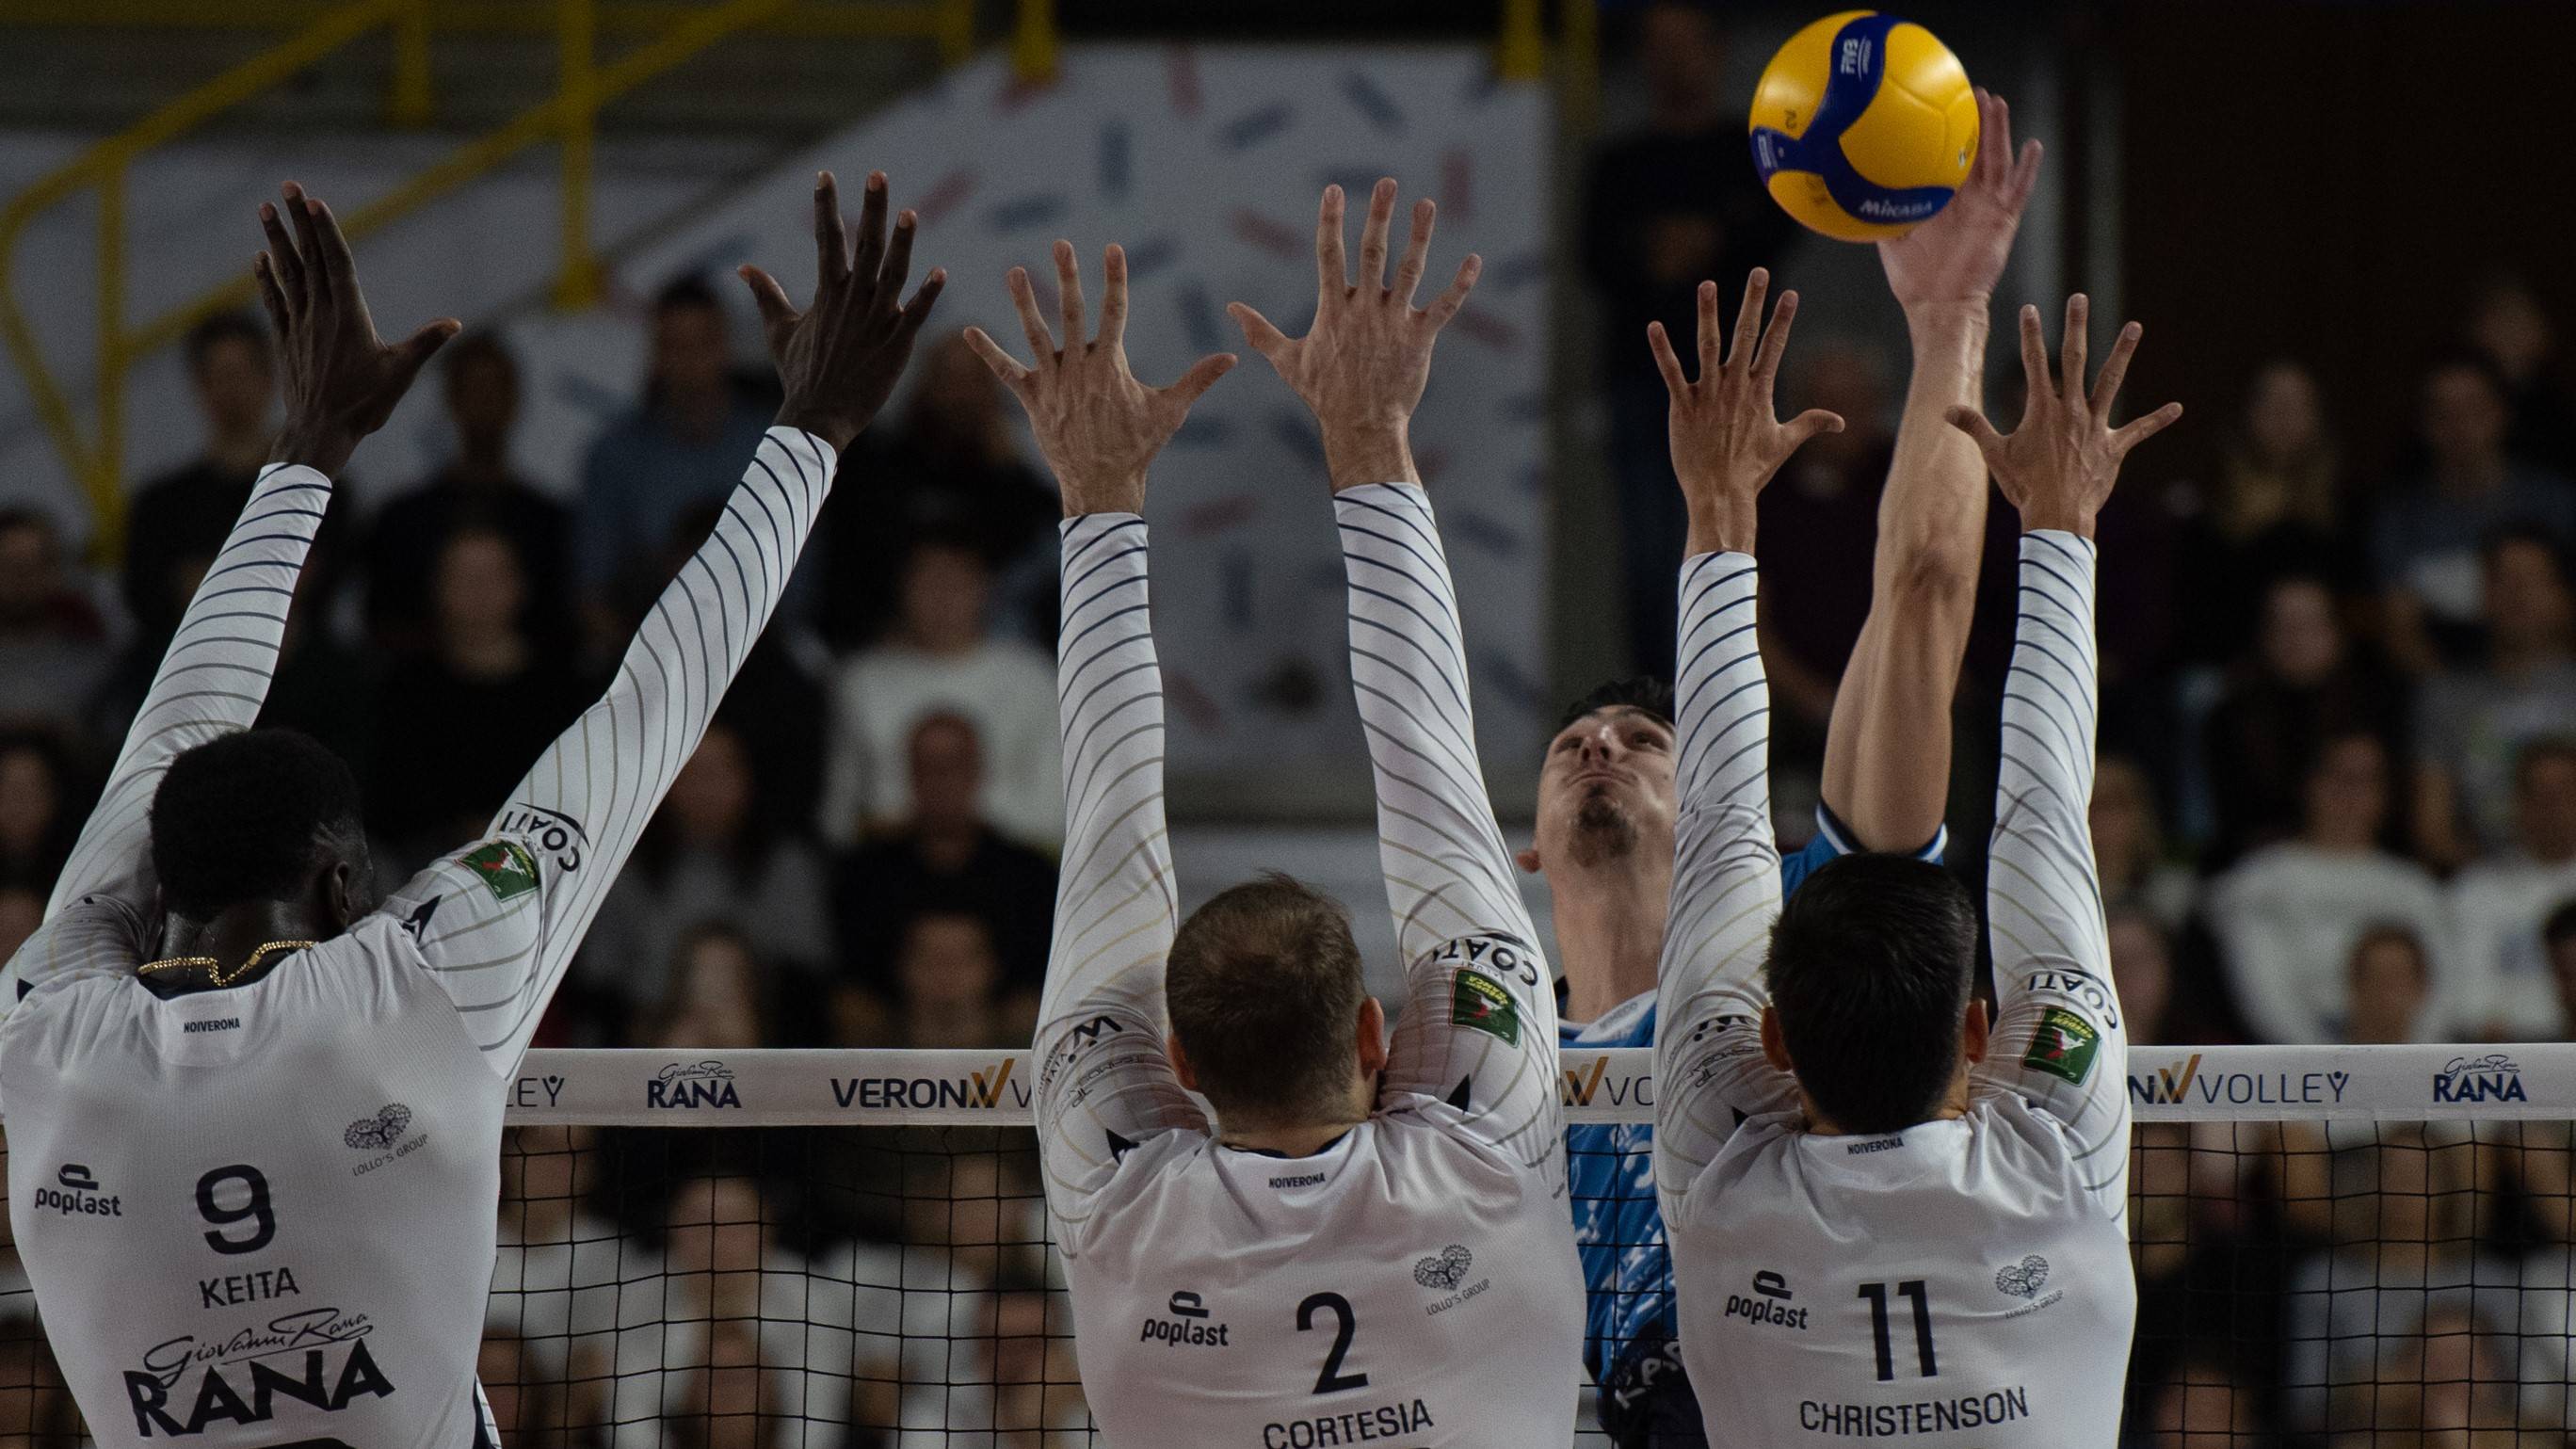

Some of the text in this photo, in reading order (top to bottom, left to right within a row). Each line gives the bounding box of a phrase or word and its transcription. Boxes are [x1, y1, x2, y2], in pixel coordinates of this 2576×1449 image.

[2028, 974, 2117, 1029] COATI
[184, 1018, 240, 1033] NOIVERONA
[648, 1080, 742, 1108] RANA
[2198, 1071, 2350, 1103] VOLLEY
[2434, 1073, 2527, 1103] RANA
[396, 1134, 428, 1157] GROUP
[1846, 1137, 1904, 1155] NOIVERONA
[1268, 1173, 1326, 1189] NOIVERONA
[35, 1187, 122, 1216] poplast
[195, 1165, 276, 1255] 9
[199, 1267, 300, 1309] KEITA
[1462, 1279, 1489, 1299] GROUP
[1725, 1295, 1808, 1330] poplast
[1140, 1316, 1229, 1347] poplast
[1296, 1291, 1369, 1395] 2
[1858, 1280, 1938, 1381] 11
[123, 1338, 396, 1437] RANA
[1264, 1399, 1434, 1449] CORTESIA
[1799, 1386, 2029, 1437] CHRISTENSON
